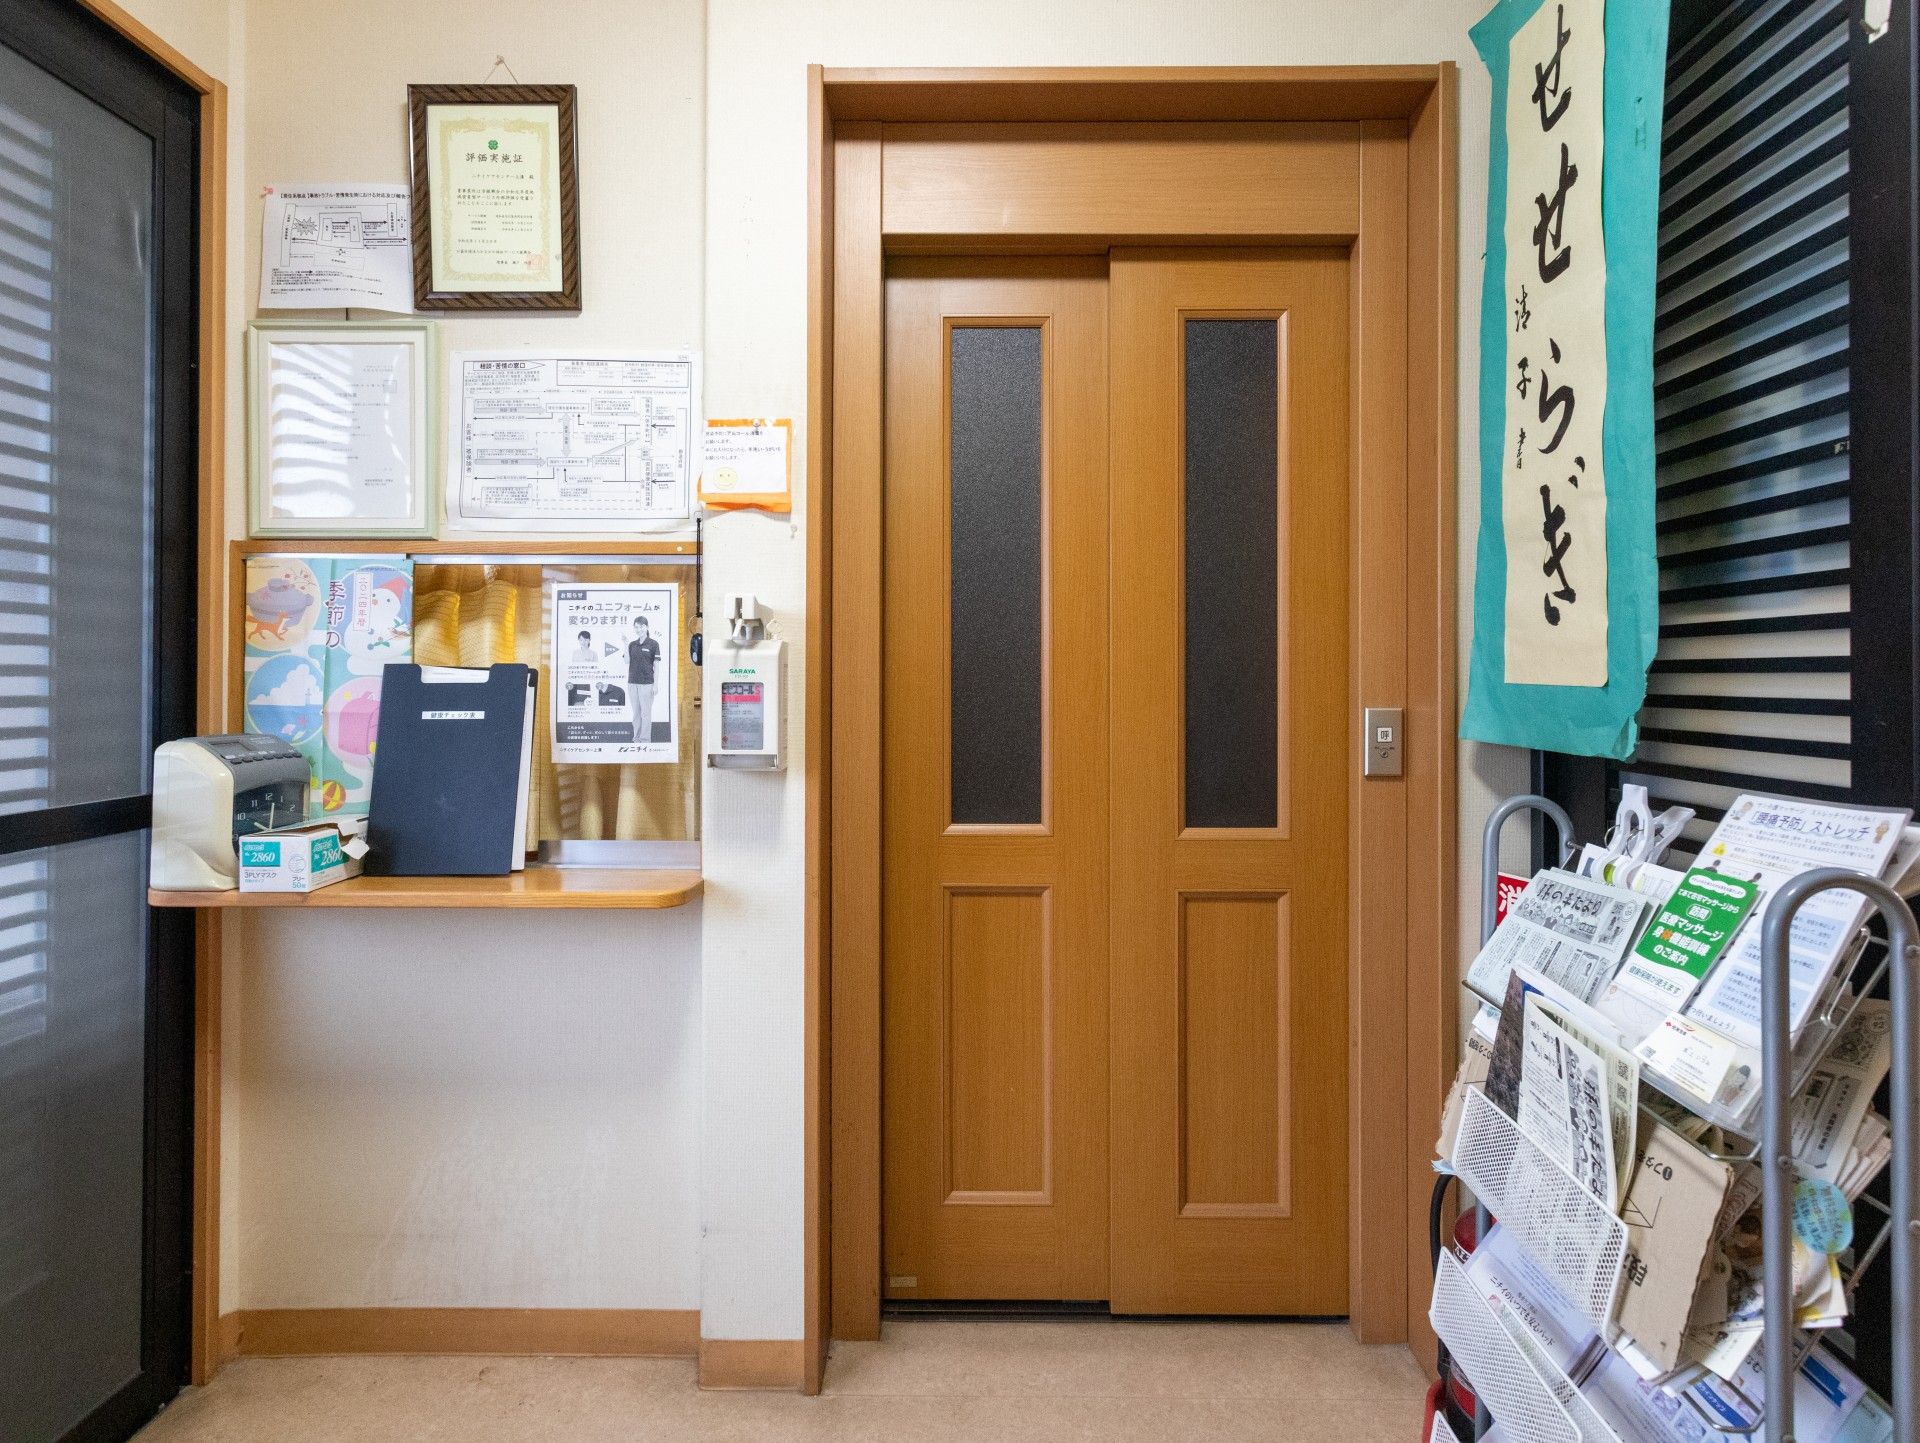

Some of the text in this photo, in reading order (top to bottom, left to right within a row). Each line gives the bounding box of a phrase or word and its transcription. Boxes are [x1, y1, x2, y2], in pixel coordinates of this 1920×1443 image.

[465, 152, 524, 164] 評価実施証
[1532, 3, 1584, 626] せせらぎ
[479, 362, 526, 370] 相談・苦情の窓口
[568, 602, 661, 612] ニチイのユニフォームが
[326, 581, 346, 648] 季節の
[1380, 730, 1390, 741] 呼
[1808, 820, 1872, 846] ストレッチ
[251, 851, 276, 863] 2860
[244, 871, 277, 880] 3PLYマスク
[1688, 904, 1709, 921] 訪問
[1658, 911, 1725, 942] 医療マッサージ
[1653, 945, 1690, 966] のご案内
